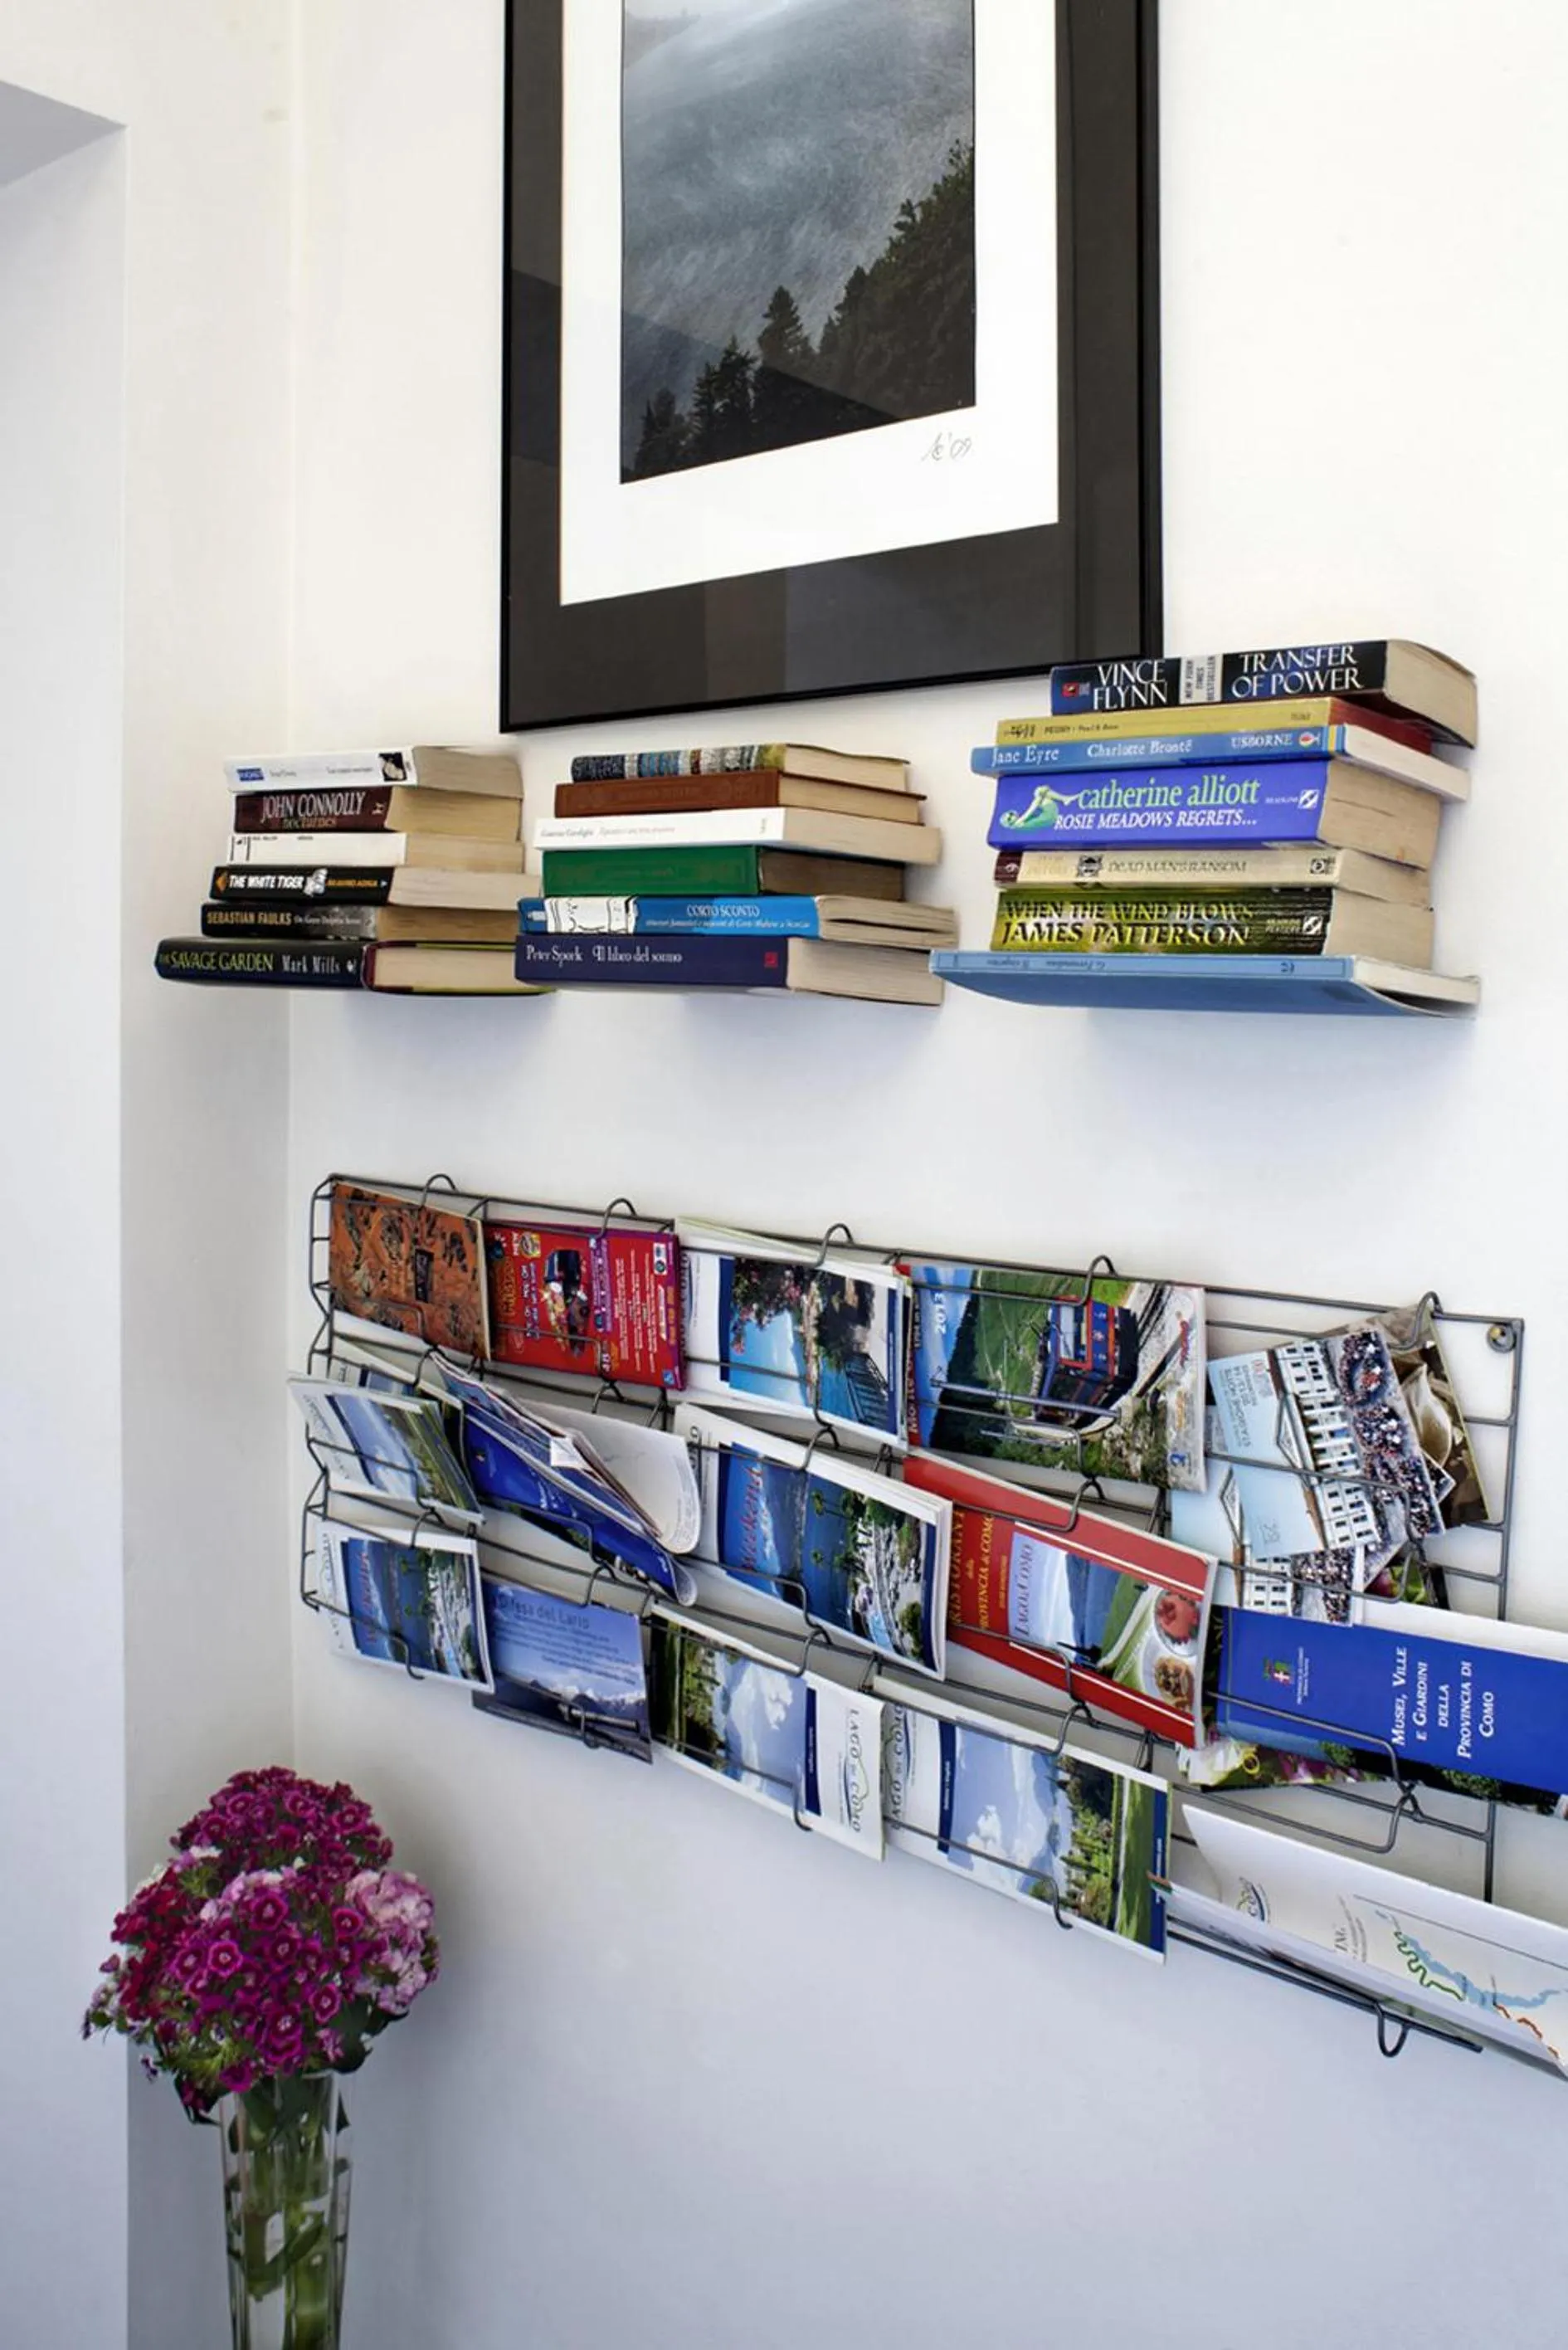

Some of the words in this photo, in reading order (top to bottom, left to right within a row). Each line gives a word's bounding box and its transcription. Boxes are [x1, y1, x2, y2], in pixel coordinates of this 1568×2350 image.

[1097, 661, 1164, 685] VINCE
[1239, 645, 1356, 674] TRANSFER
[1093, 682, 1167, 711] FLYNN
[1231, 675, 1264, 699] OF
[1269, 666, 1364, 695] POWER
[991, 747, 1020, 767] Jane
[1025, 744, 1059, 764] Eyre
[1087, 742, 1145, 758] Charlotte
[1230, 734, 1293, 748] USBORNE
[1079, 778, 1181, 810] catherine
[1186, 775, 1259, 807] alliott
[261, 795, 295, 823] JOHN
[297, 792, 366, 817] CONNOLLY
[1054, 812, 1095, 831] ROSIE
[1097, 811, 1173, 829] MEADOWS
[229, 875, 246, 888] THE
[249, 875, 276, 889] WHITE
[277, 876, 304, 889] TIGER
[207, 912, 255, 924] SEBASTIAN
[258, 913, 290, 925] FAULKS
[719, 904, 760, 917] SCONTO
[1006, 901, 1064, 920] WHEN
[1069, 900, 1103, 920] THE
[1110, 901, 1169, 921] WIND
[1176, 902, 1254, 921] BLOWS
[1002, 922, 1083, 947] JAMES
[1092, 922, 1249, 947] PATTERSON
[171, 951, 217, 970] SAVAGE
[219, 952, 274, 971] GARDEN
[283, 954, 307, 973] Mark
[313, 955, 340, 973] Mills
[525, 944, 552, 961] Peter
[553, 945, 582, 968] Spork
[608, 947, 631, 963] libro
[634, 946, 650, 963] del
[933, 1291, 947, 1334] 2013
[1015, 1597, 1030, 1636] LAGO
[1439, 1684, 1449, 1728] DELLA
[850, 1709, 862, 1759] LAGO
[850, 1782, 862, 1833] COMO
